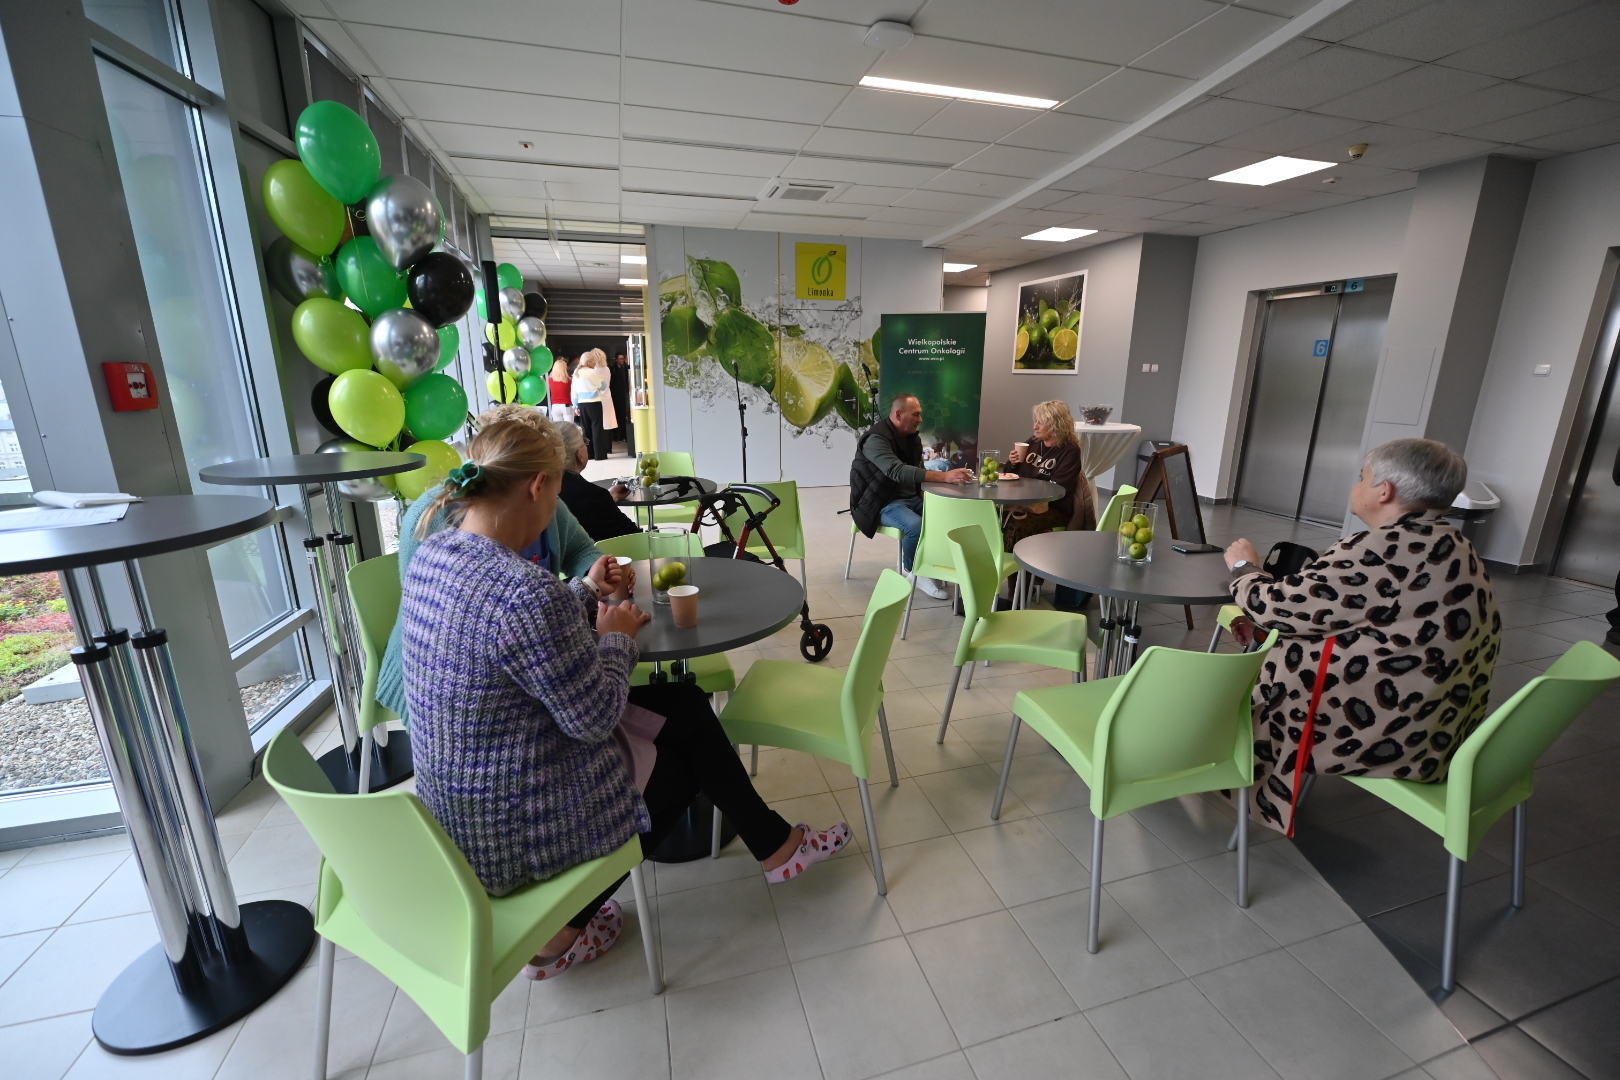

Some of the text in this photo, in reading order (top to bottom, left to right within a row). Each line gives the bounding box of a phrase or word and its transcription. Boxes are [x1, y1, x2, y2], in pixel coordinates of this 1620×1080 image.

[1350, 281, 1358, 290] 6
[807, 287, 834, 297] Limonka
[907, 338, 957, 346] Wielkopolskie
[898, 347, 966, 356] Centrum Onkologii
[1316, 341, 1327, 355] 6
